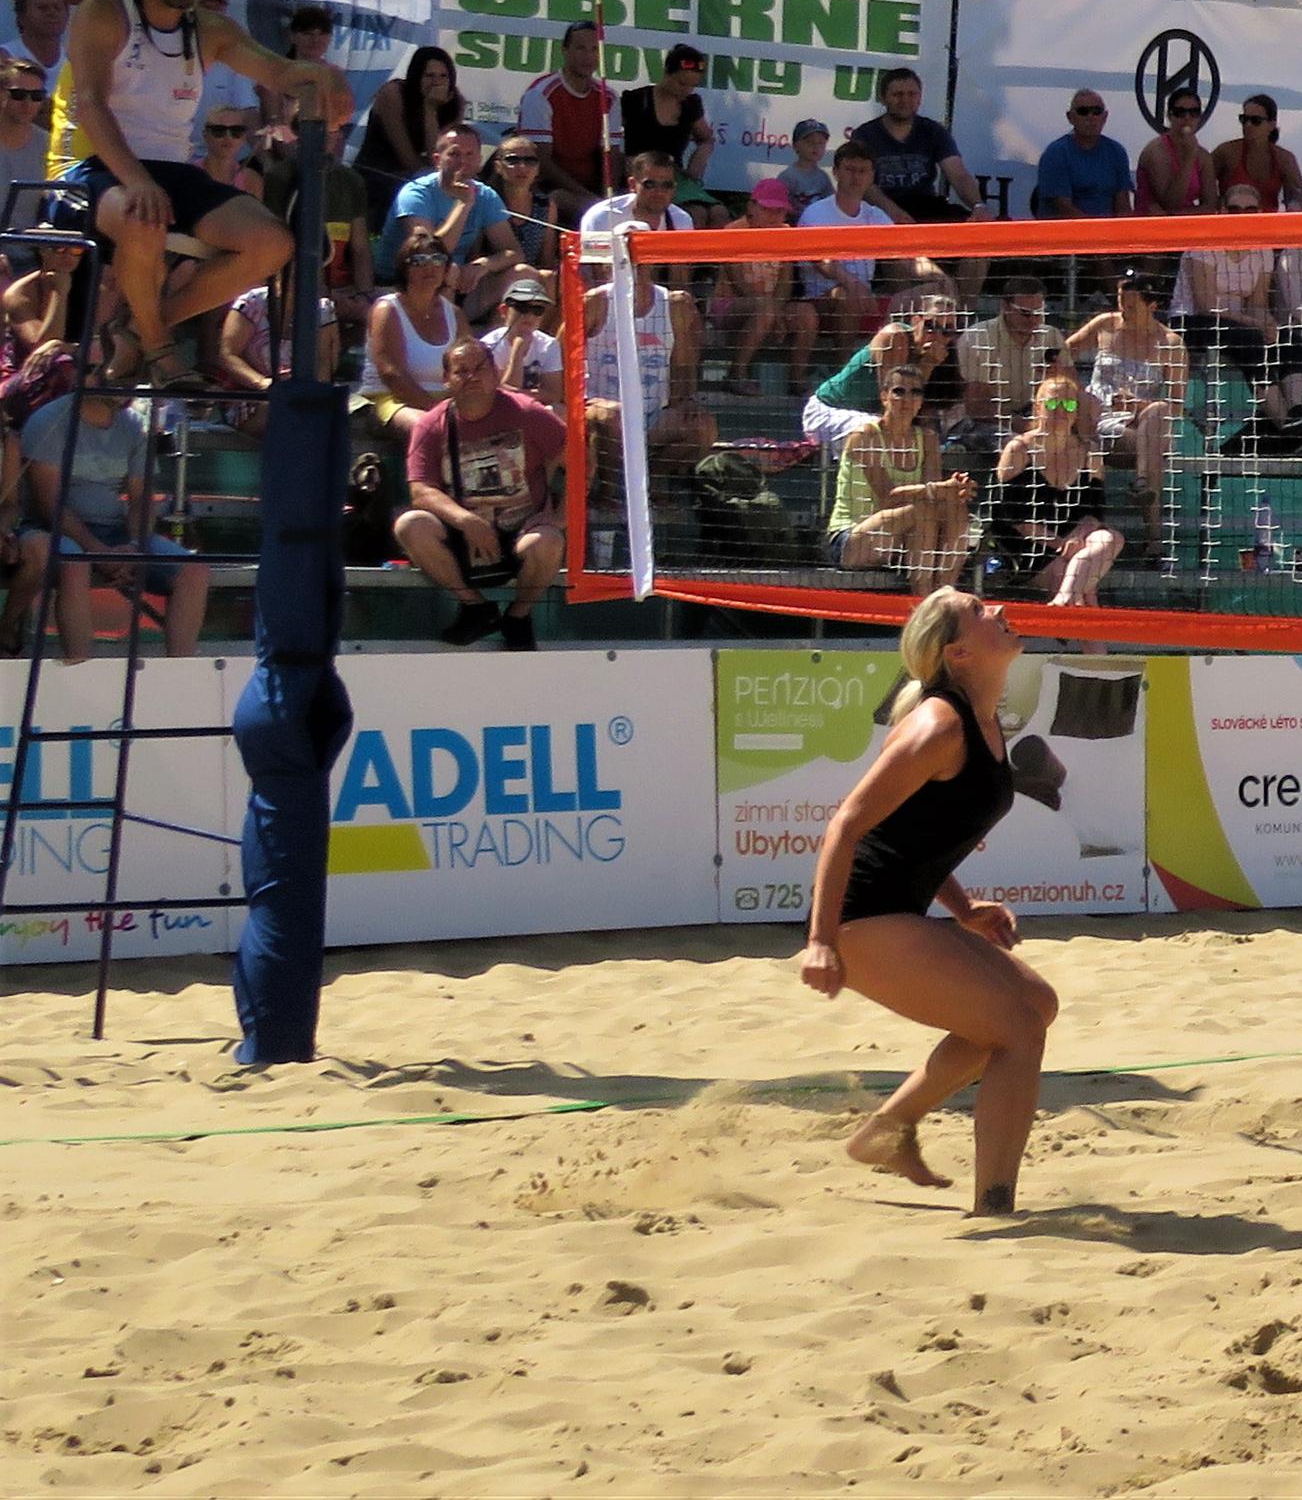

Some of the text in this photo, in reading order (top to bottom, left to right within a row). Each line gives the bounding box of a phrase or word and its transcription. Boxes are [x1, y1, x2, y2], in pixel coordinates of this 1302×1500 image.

[332, 723, 621, 822] ADELL
[735, 799, 790, 822] zimní
[422, 814, 626, 869] TRADING
[736, 830, 826, 860] Ubytov
[765, 883, 804, 909] 725
